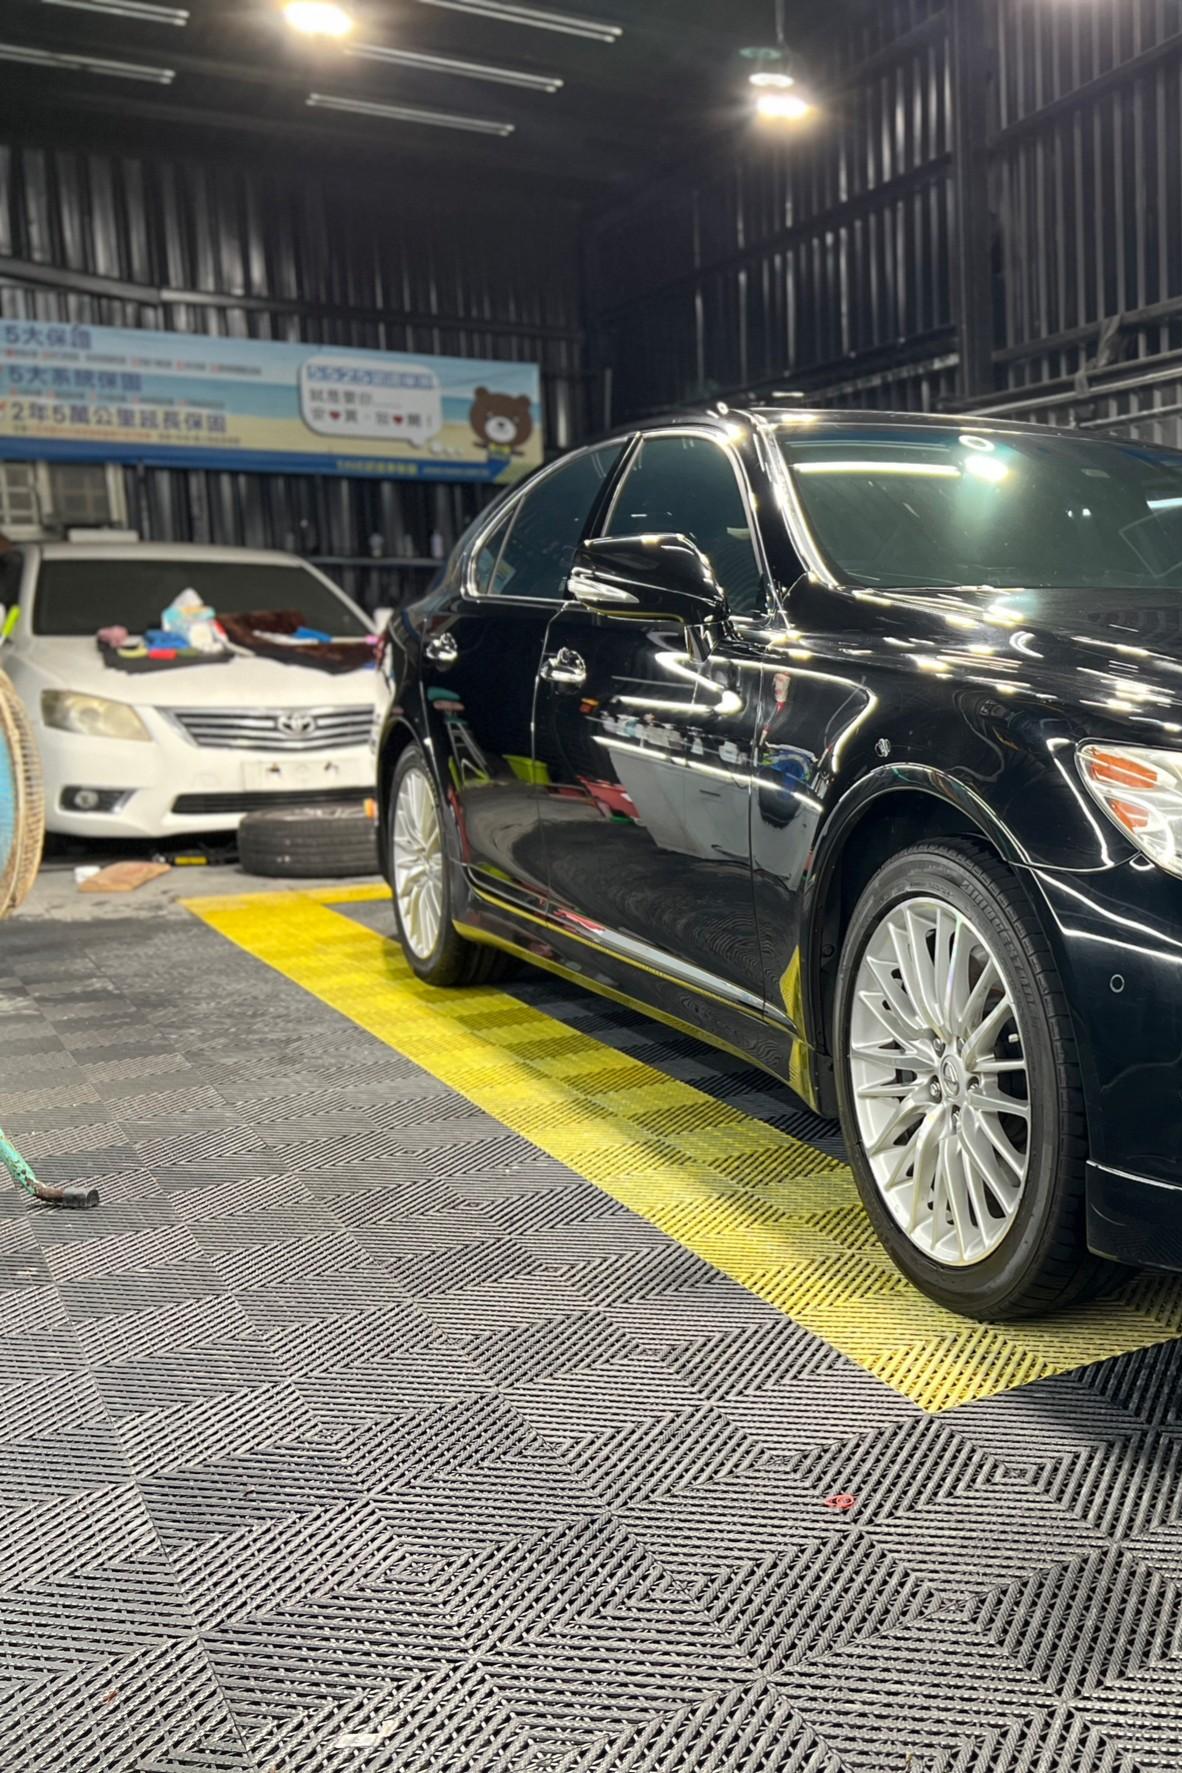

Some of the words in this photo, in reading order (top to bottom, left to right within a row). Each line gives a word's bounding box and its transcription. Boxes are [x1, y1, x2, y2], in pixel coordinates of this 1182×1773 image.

[11, 402, 228, 433] 2年5萬公里延長保固
